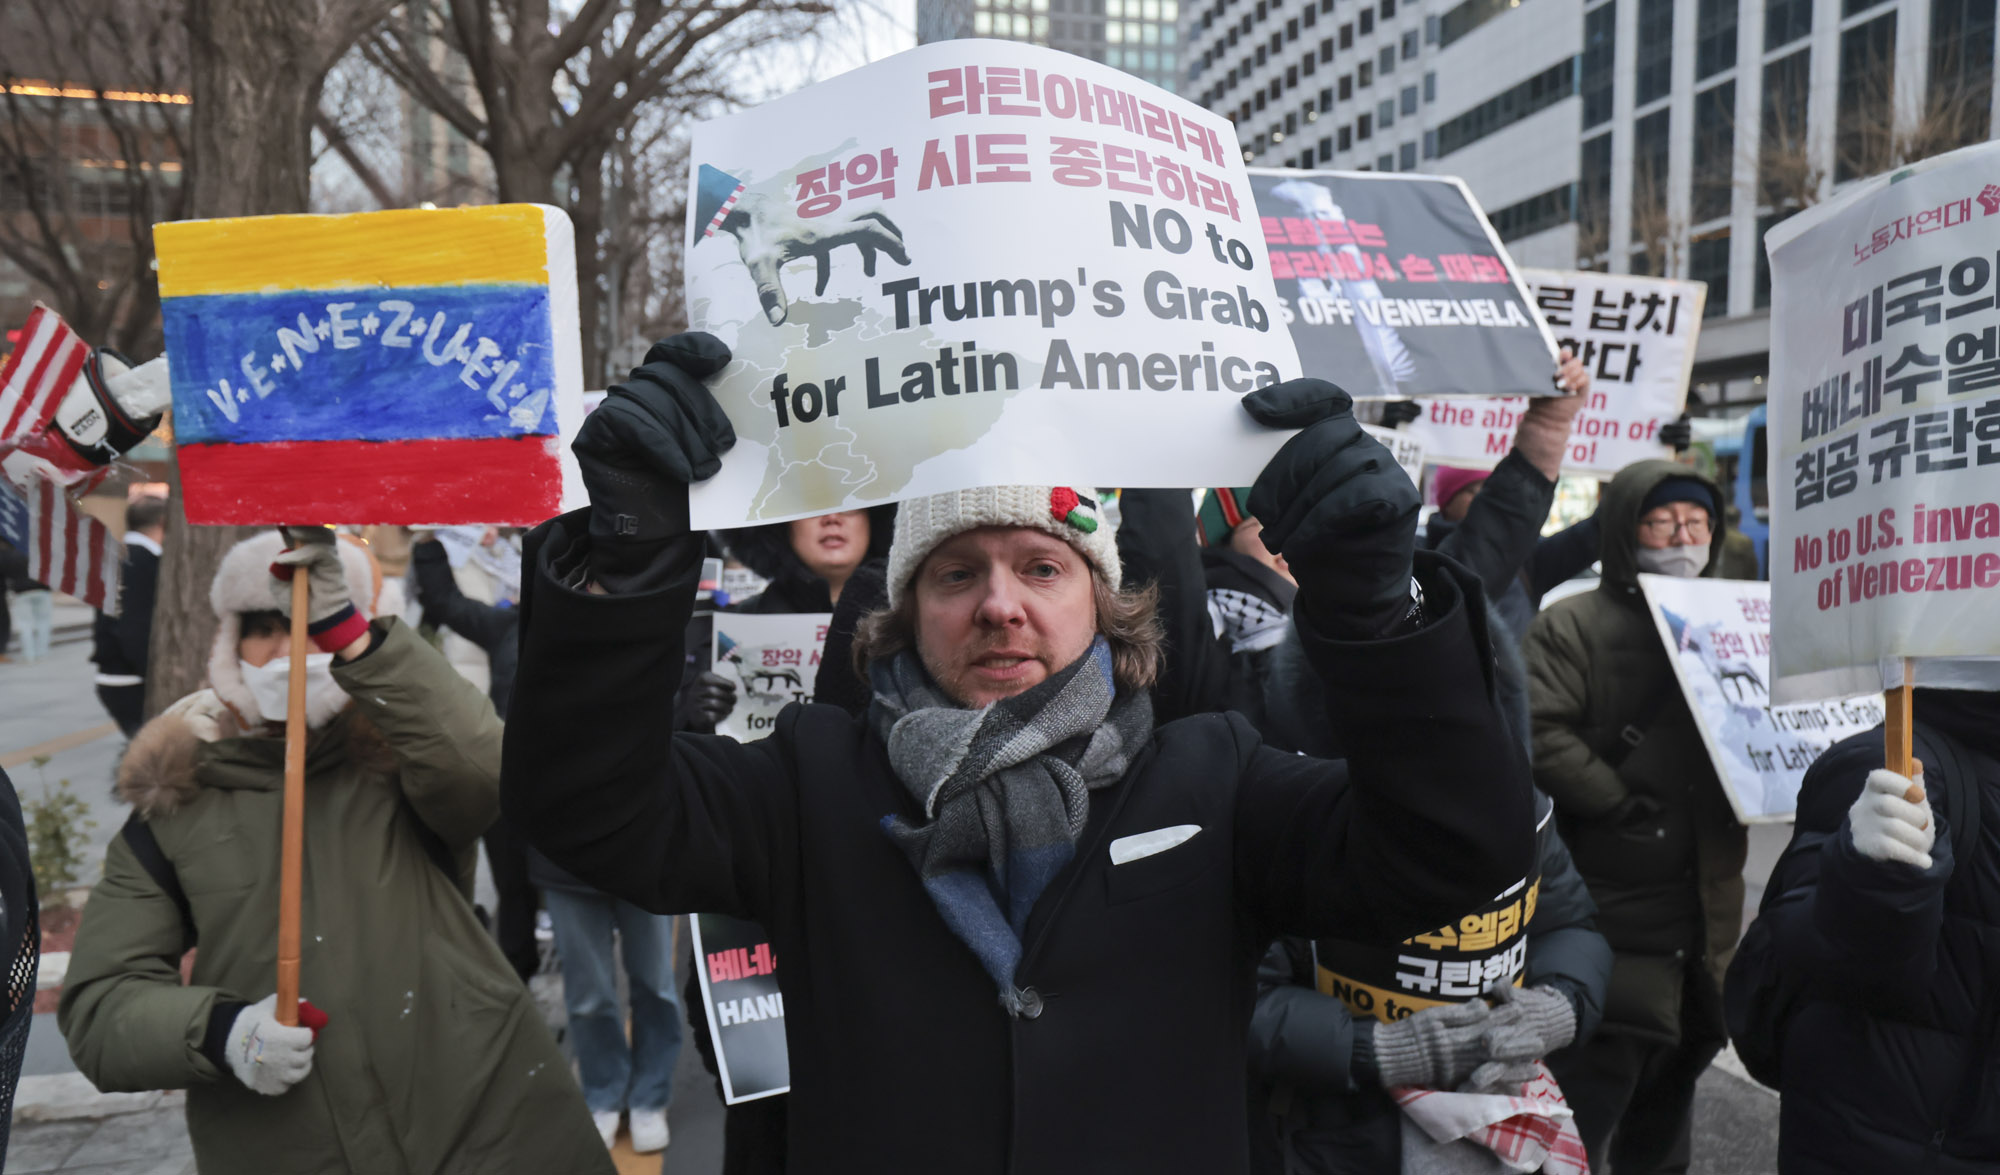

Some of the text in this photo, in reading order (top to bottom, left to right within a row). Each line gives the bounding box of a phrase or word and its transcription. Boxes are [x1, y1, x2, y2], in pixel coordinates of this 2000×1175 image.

[927, 65, 1226, 169] 라틴아메리카
[795, 133, 1241, 222] 장악 시도 중단하라
[1110, 201, 1254, 271] NO to
[1853, 197, 1972, 267] 노동자연대
[882, 267, 1125, 330] Trump's
[1144, 270, 1270, 333] Grab
[1298, 297, 1355, 325] OFF
[1358, 298, 1531, 327] VENEZUELA
[1589, 290, 1680, 335] 납치
[1842, 249, 2000, 357] 미국의
[770, 338, 1280, 428] for Latin America
[1430, 401, 1474, 426] the
[1628, 418, 1658, 441] of
[1794, 433, 1859, 511] 침공
[1794, 534, 1822, 574] No
[1827, 528, 1850, 564] to
[1857, 507, 1904, 556] U.S.
[1817, 552, 2000, 612] of Venezue
[762, 649, 802, 667] 장악
[747, 713, 775, 730] for
[1402, 899, 1522, 952] 수엘라
[707, 943, 777, 984] 베네
[1332, 979, 1413, 1021] NO to
